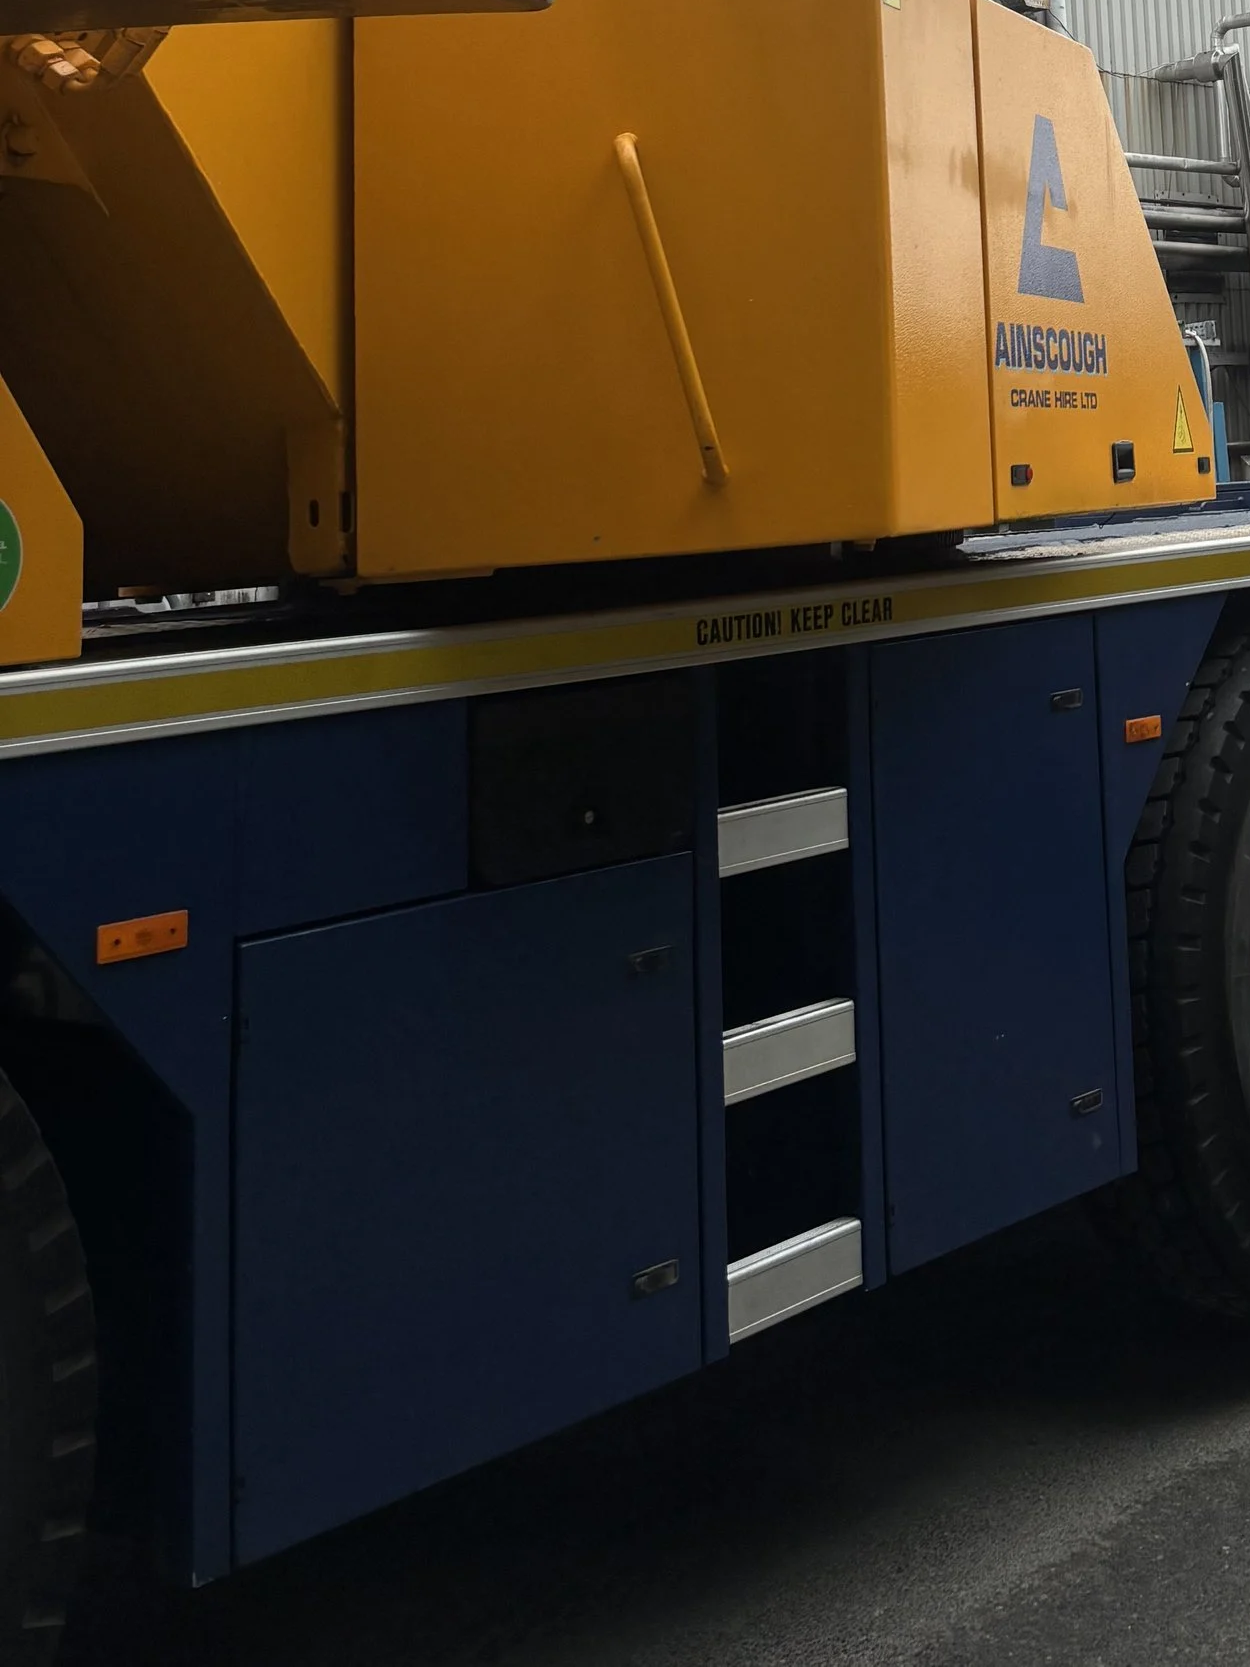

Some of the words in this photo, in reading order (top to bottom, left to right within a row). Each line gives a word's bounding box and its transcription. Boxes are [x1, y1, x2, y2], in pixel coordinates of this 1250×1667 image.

[995, 321, 1108, 376] AINSCOUGH
[1010, 388, 1051, 409] CRANE
[1054, 391, 1078, 409] HIRE
[1081, 392, 1098, 410] LTD
[696, 609, 782, 646] CAUTION!
[790, 603, 834, 634] KEEP
[841, 596, 893, 627] CLEAR
